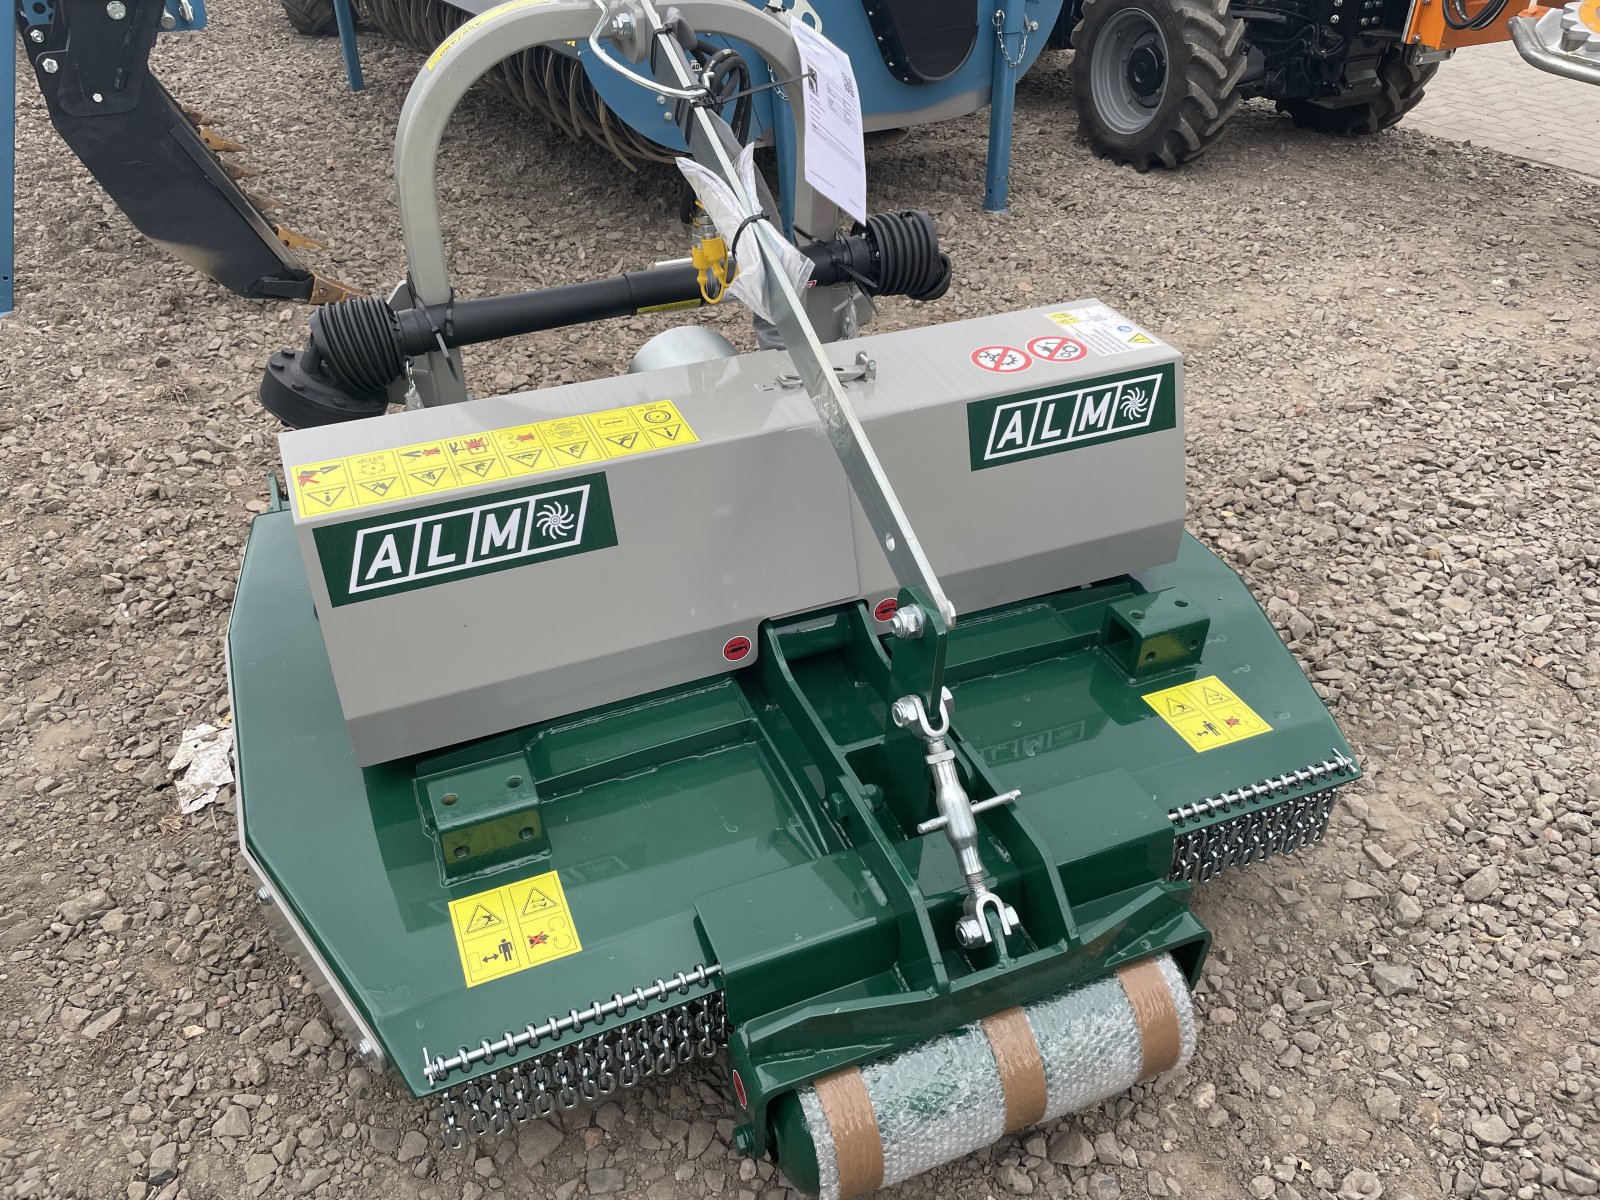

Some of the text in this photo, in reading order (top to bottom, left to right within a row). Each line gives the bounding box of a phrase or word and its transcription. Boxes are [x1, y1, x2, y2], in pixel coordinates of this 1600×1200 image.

[996, 392, 1113, 450] ALM
[357, 455, 384, 464] STOP
[364, 507, 523, 580] ALM
